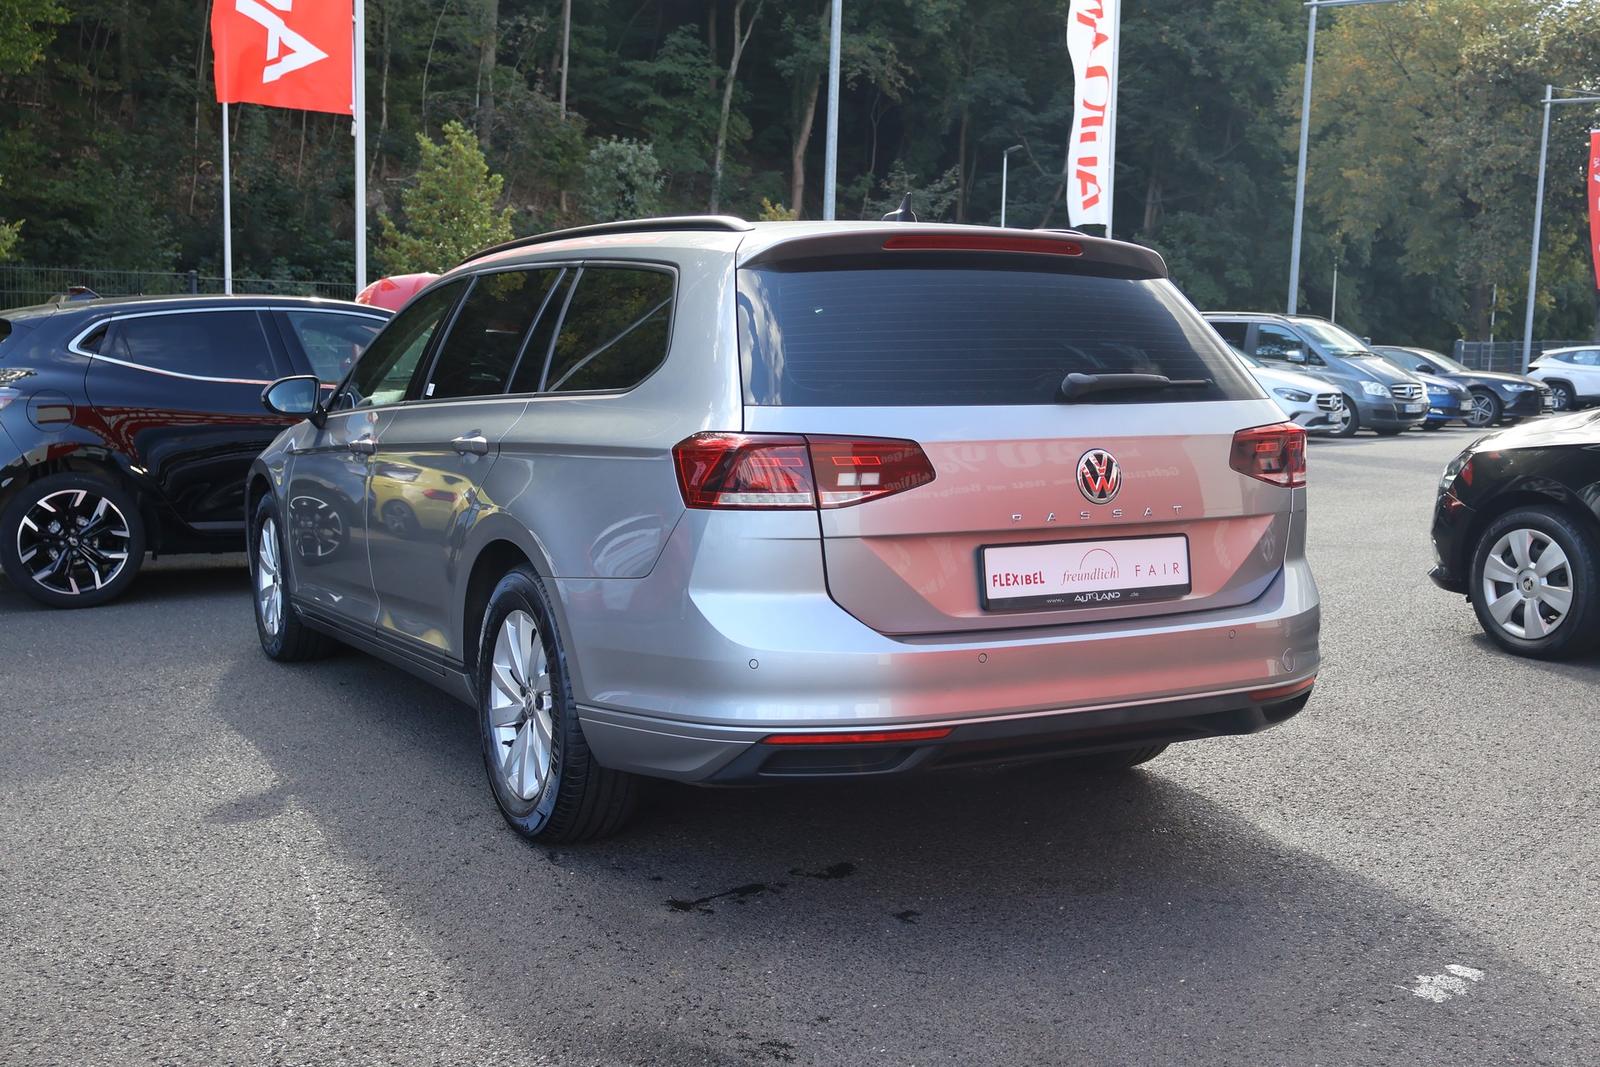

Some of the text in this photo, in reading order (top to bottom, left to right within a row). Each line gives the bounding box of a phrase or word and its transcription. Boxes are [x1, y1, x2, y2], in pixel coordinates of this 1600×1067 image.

[1012, 505, 1182, 522] PASSAT
[992, 562, 1180, 588] FLEXIBEL freundlich FAIR
[1074, 592, 1121, 603] AUTOLAND
